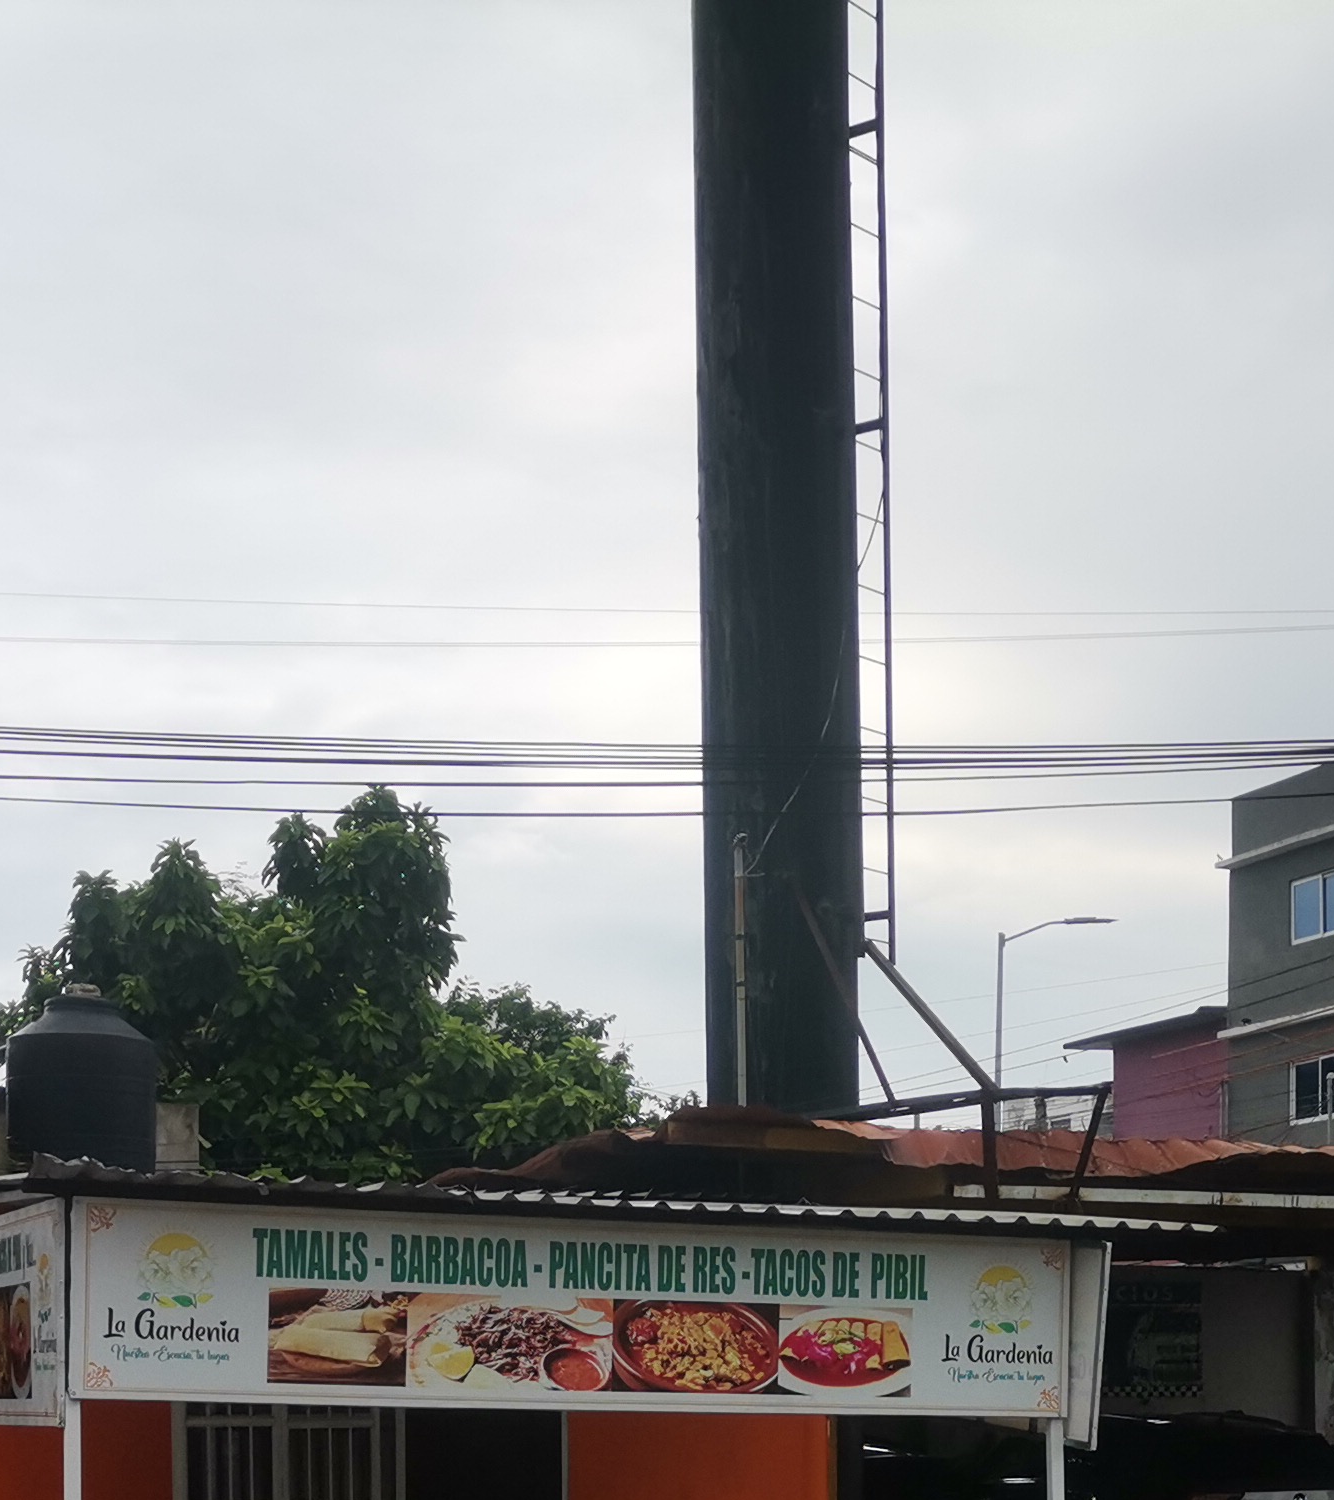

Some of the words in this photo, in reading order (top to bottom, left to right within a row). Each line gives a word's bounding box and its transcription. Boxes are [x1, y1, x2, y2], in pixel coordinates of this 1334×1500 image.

[252, 1227, 368, 1283] TAMALES
[390, 1233, 529, 1288] BARBACOA
[548, 1240, 652, 1292] PANCITA
[657, 1244, 687, 1293] DE
[692, 1245, 737, 1296] RES
[831, 1250, 861, 1299] DE
[870, 1251, 928, 1301] PIBIL
[103, 1306, 126, 1339] La
[134, 1307, 240, 1343] Gardenia
[941, 1333, 961, 1363] La
[966, 1333, 1053, 1365] Gardenia
